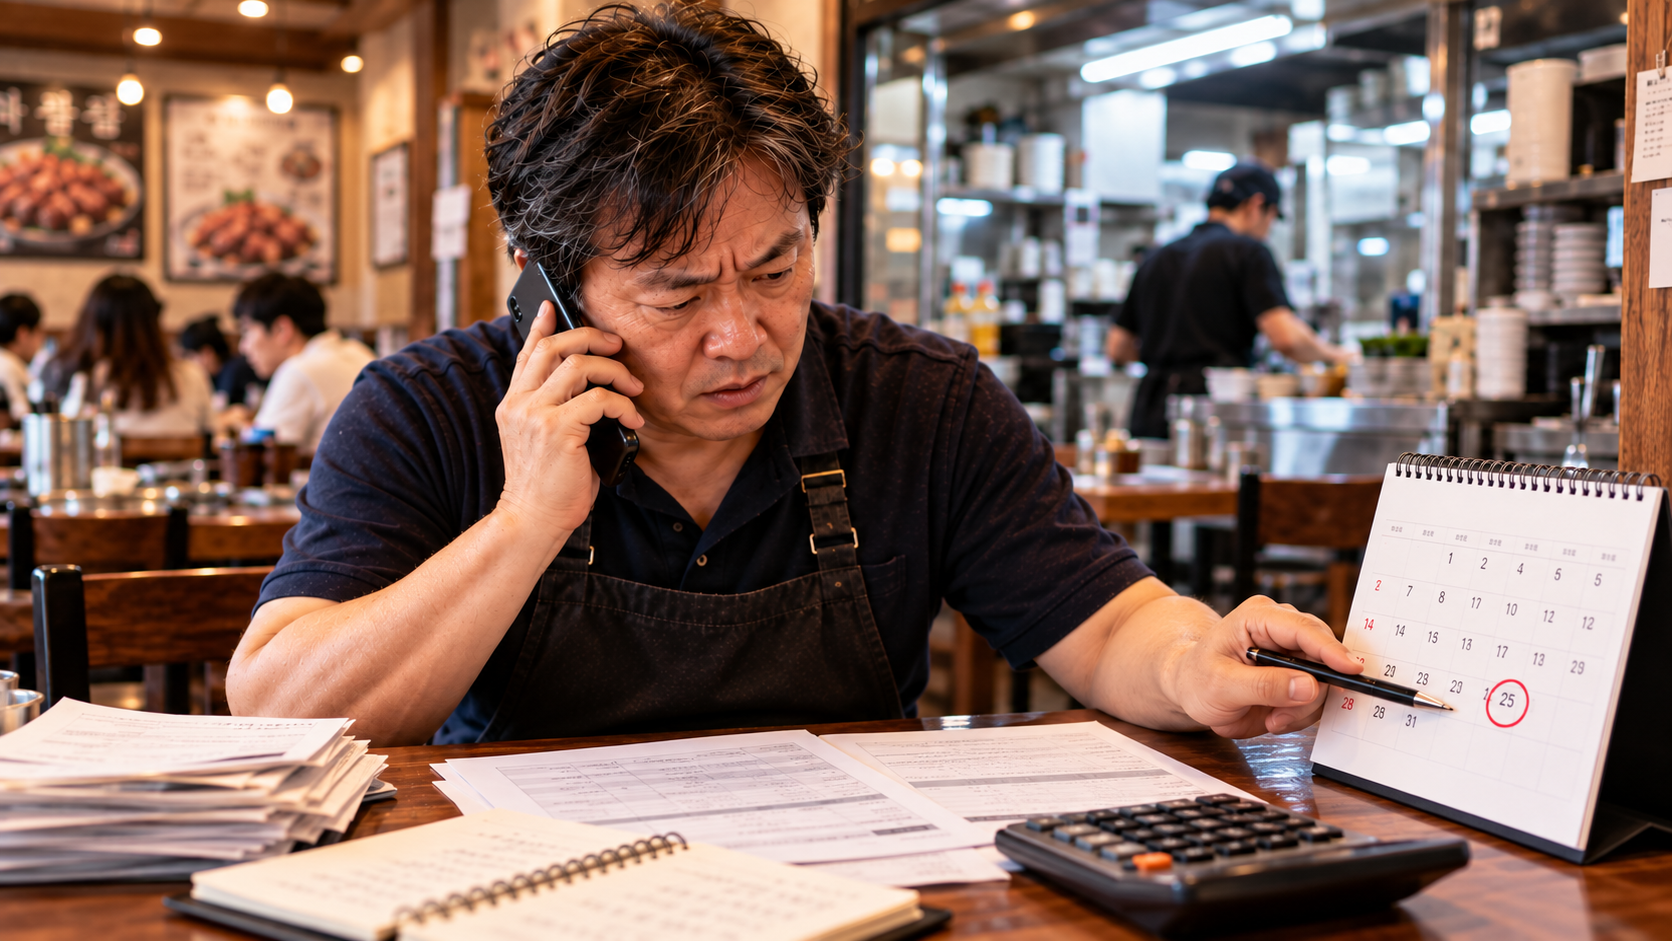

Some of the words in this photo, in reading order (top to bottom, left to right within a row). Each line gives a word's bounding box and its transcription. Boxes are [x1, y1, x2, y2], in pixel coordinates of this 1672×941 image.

[1448, 552, 1454, 565] 1
[1480, 556, 1488, 570] 2
[1516, 562, 1524, 575] 4
[1406, 584, 1414, 597] 7
[1438, 590, 1446, 604] 8
[1471, 596, 1482, 610] 17
[1506, 602, 1518, 617] 10
[1543, 609, 1555, 624] 12
[1582, 616, 1595, 631] 12
[1363, 617, 1375, 631] 14
[1395, 624, 1406, 637] 14
[1496, 644, 1509, 659] 17
[1341, 696, 1355, 711] 28
[1372, 704, 1386, 720] 28
[1405, 713, 1417, 729] 31
[1498, 691, 1516, 708] 25
